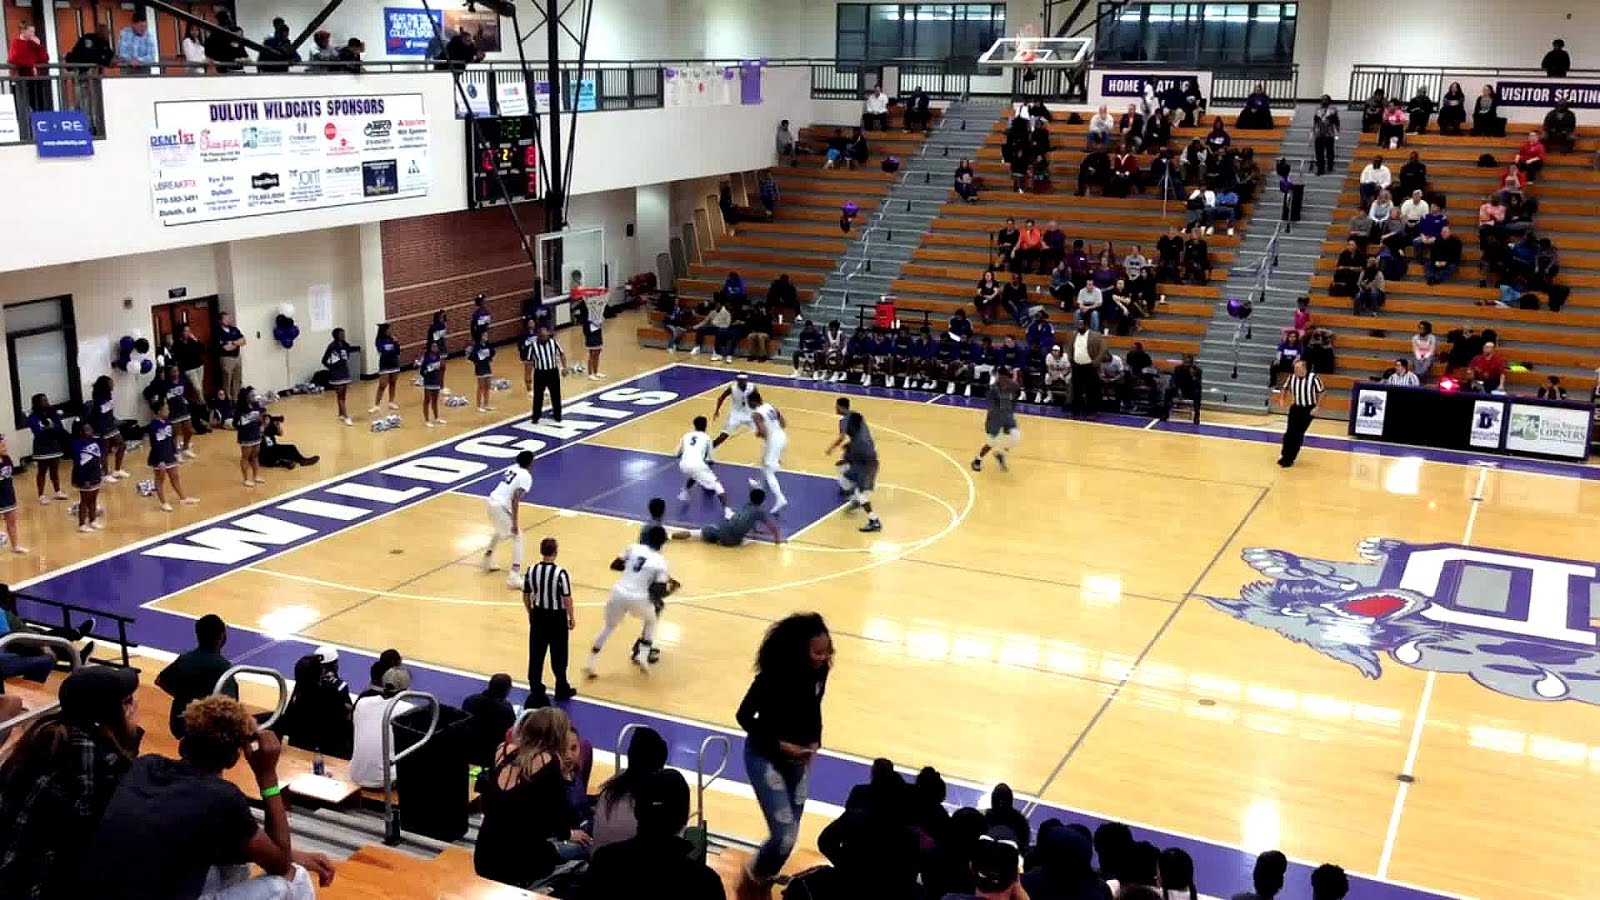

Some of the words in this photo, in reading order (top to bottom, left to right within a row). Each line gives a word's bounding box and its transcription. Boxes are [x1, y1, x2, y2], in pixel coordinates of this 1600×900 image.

[1108, 79, 1139, 92] HOME
[1501, 87, 1550, 102] VISITOR
[1554, 88, 1600, 104] SEATIN
[209, 102, 258, 122] DULUTH
[264, 100, 322, 119] WILDCATS
[326, 99, 385, 116] SPONSORS
[501, 148, 510, 161] 2
[140, 387, 682, 566] WILDCATS
